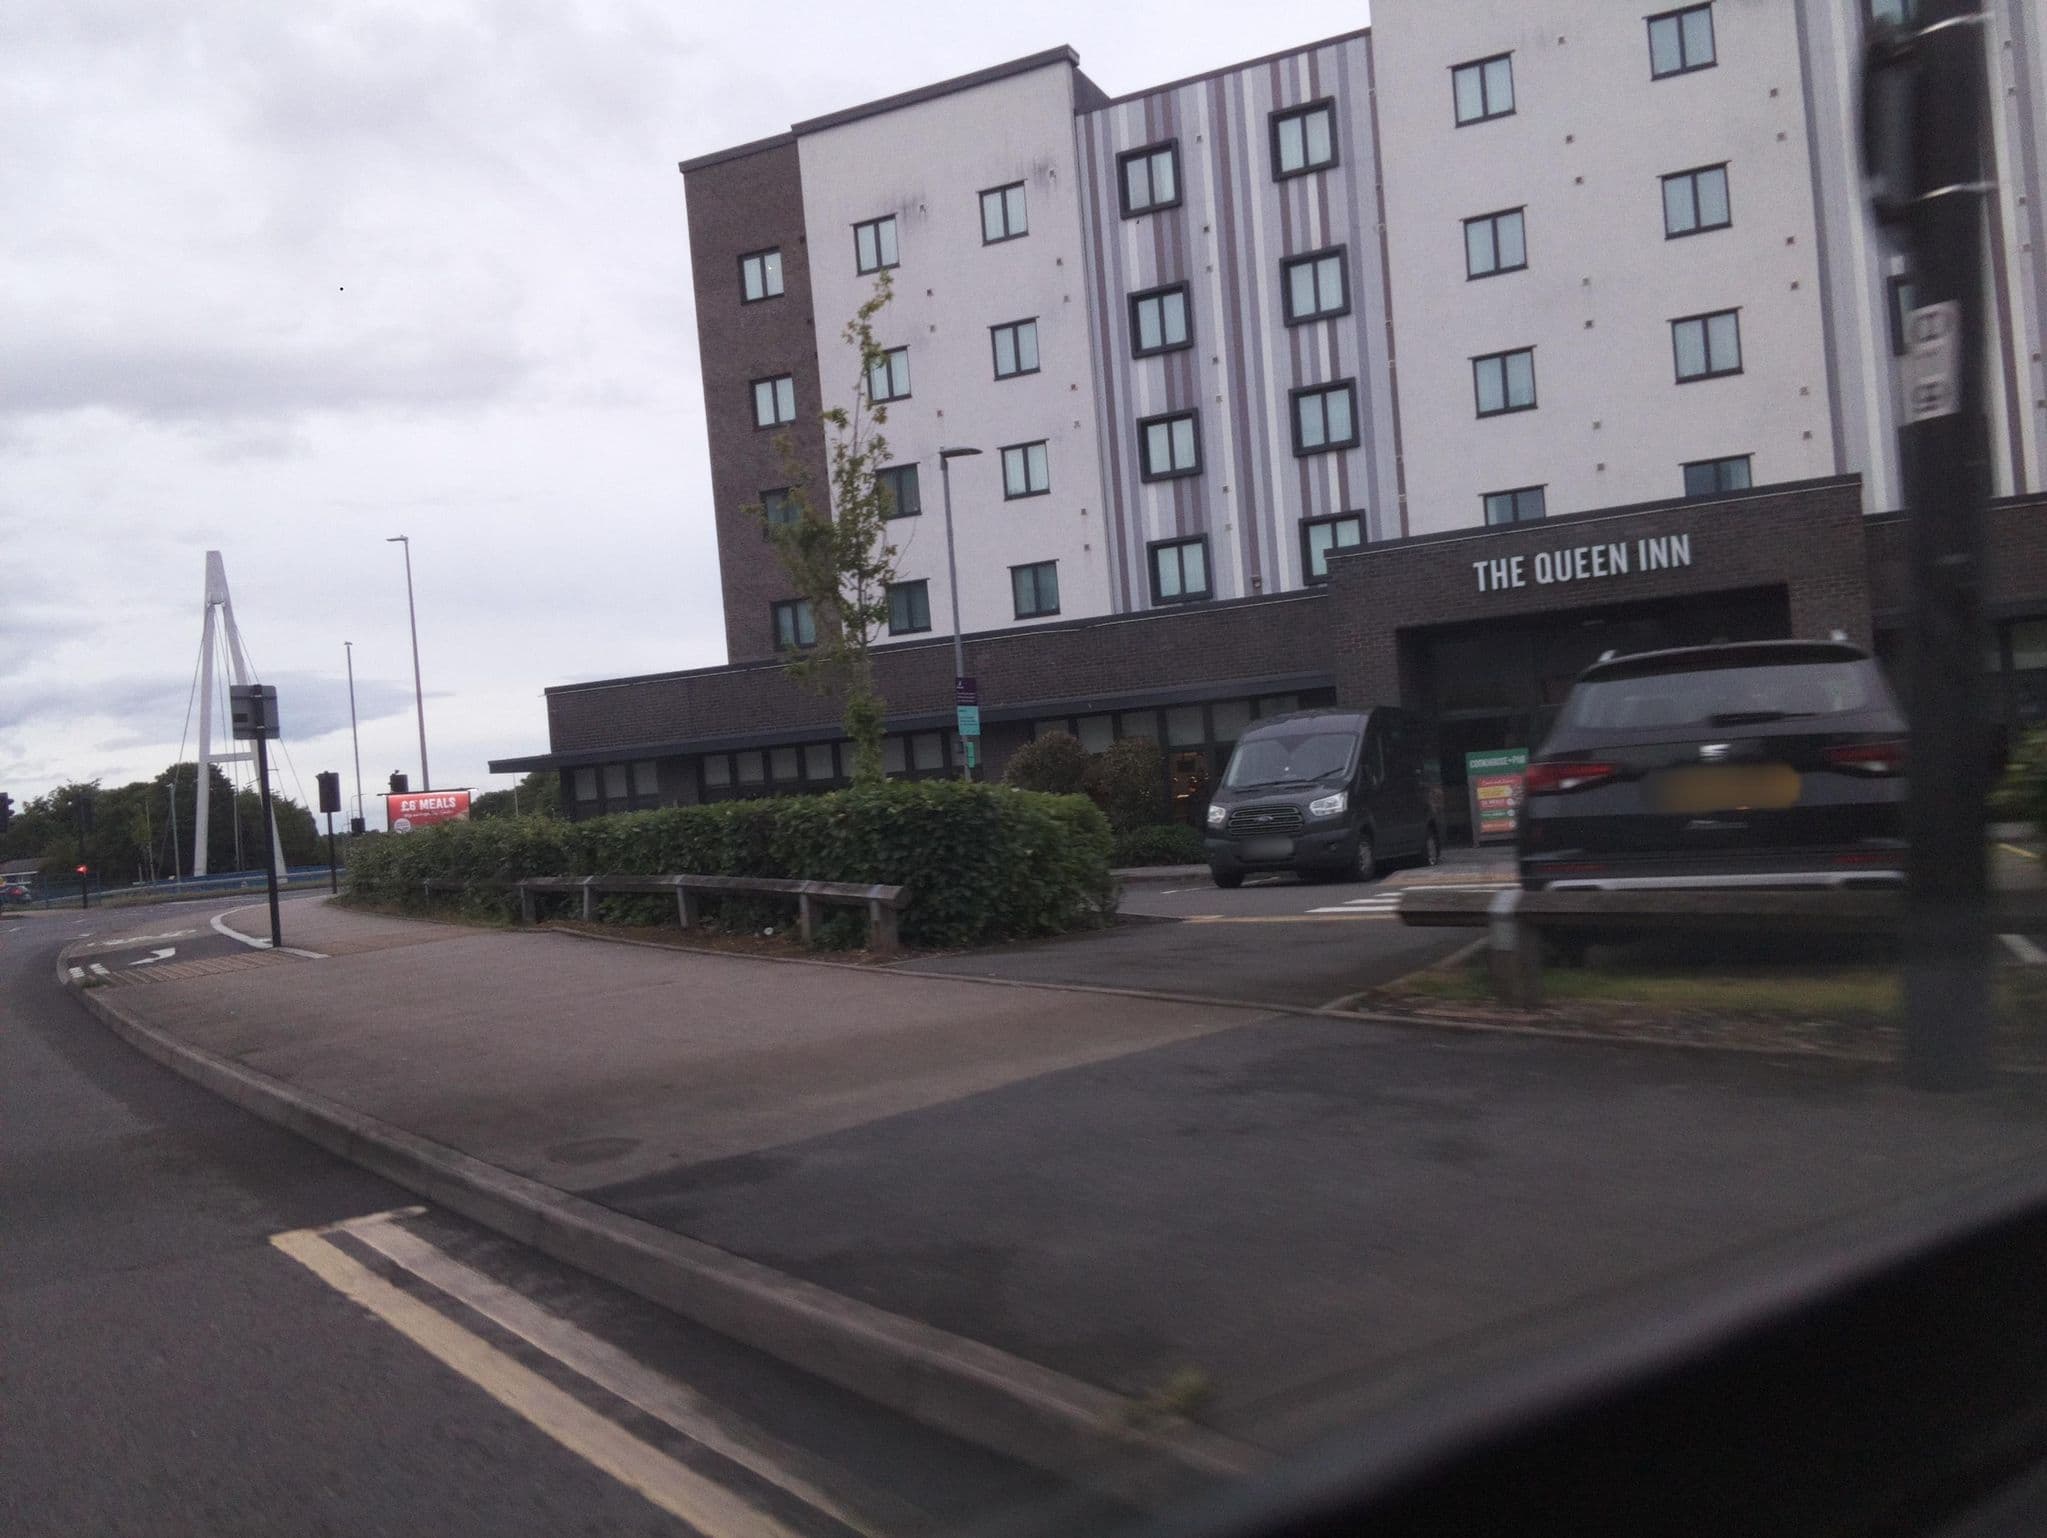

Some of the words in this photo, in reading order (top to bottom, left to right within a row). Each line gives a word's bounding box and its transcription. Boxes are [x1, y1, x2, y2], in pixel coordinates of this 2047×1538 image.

[1473, 556, 1526, 592] THE
[1534, 542, 1629, 585] QUEEN
[1638, 534, 1691, 572] INN
[419, 797, 456, 810] MEALS
